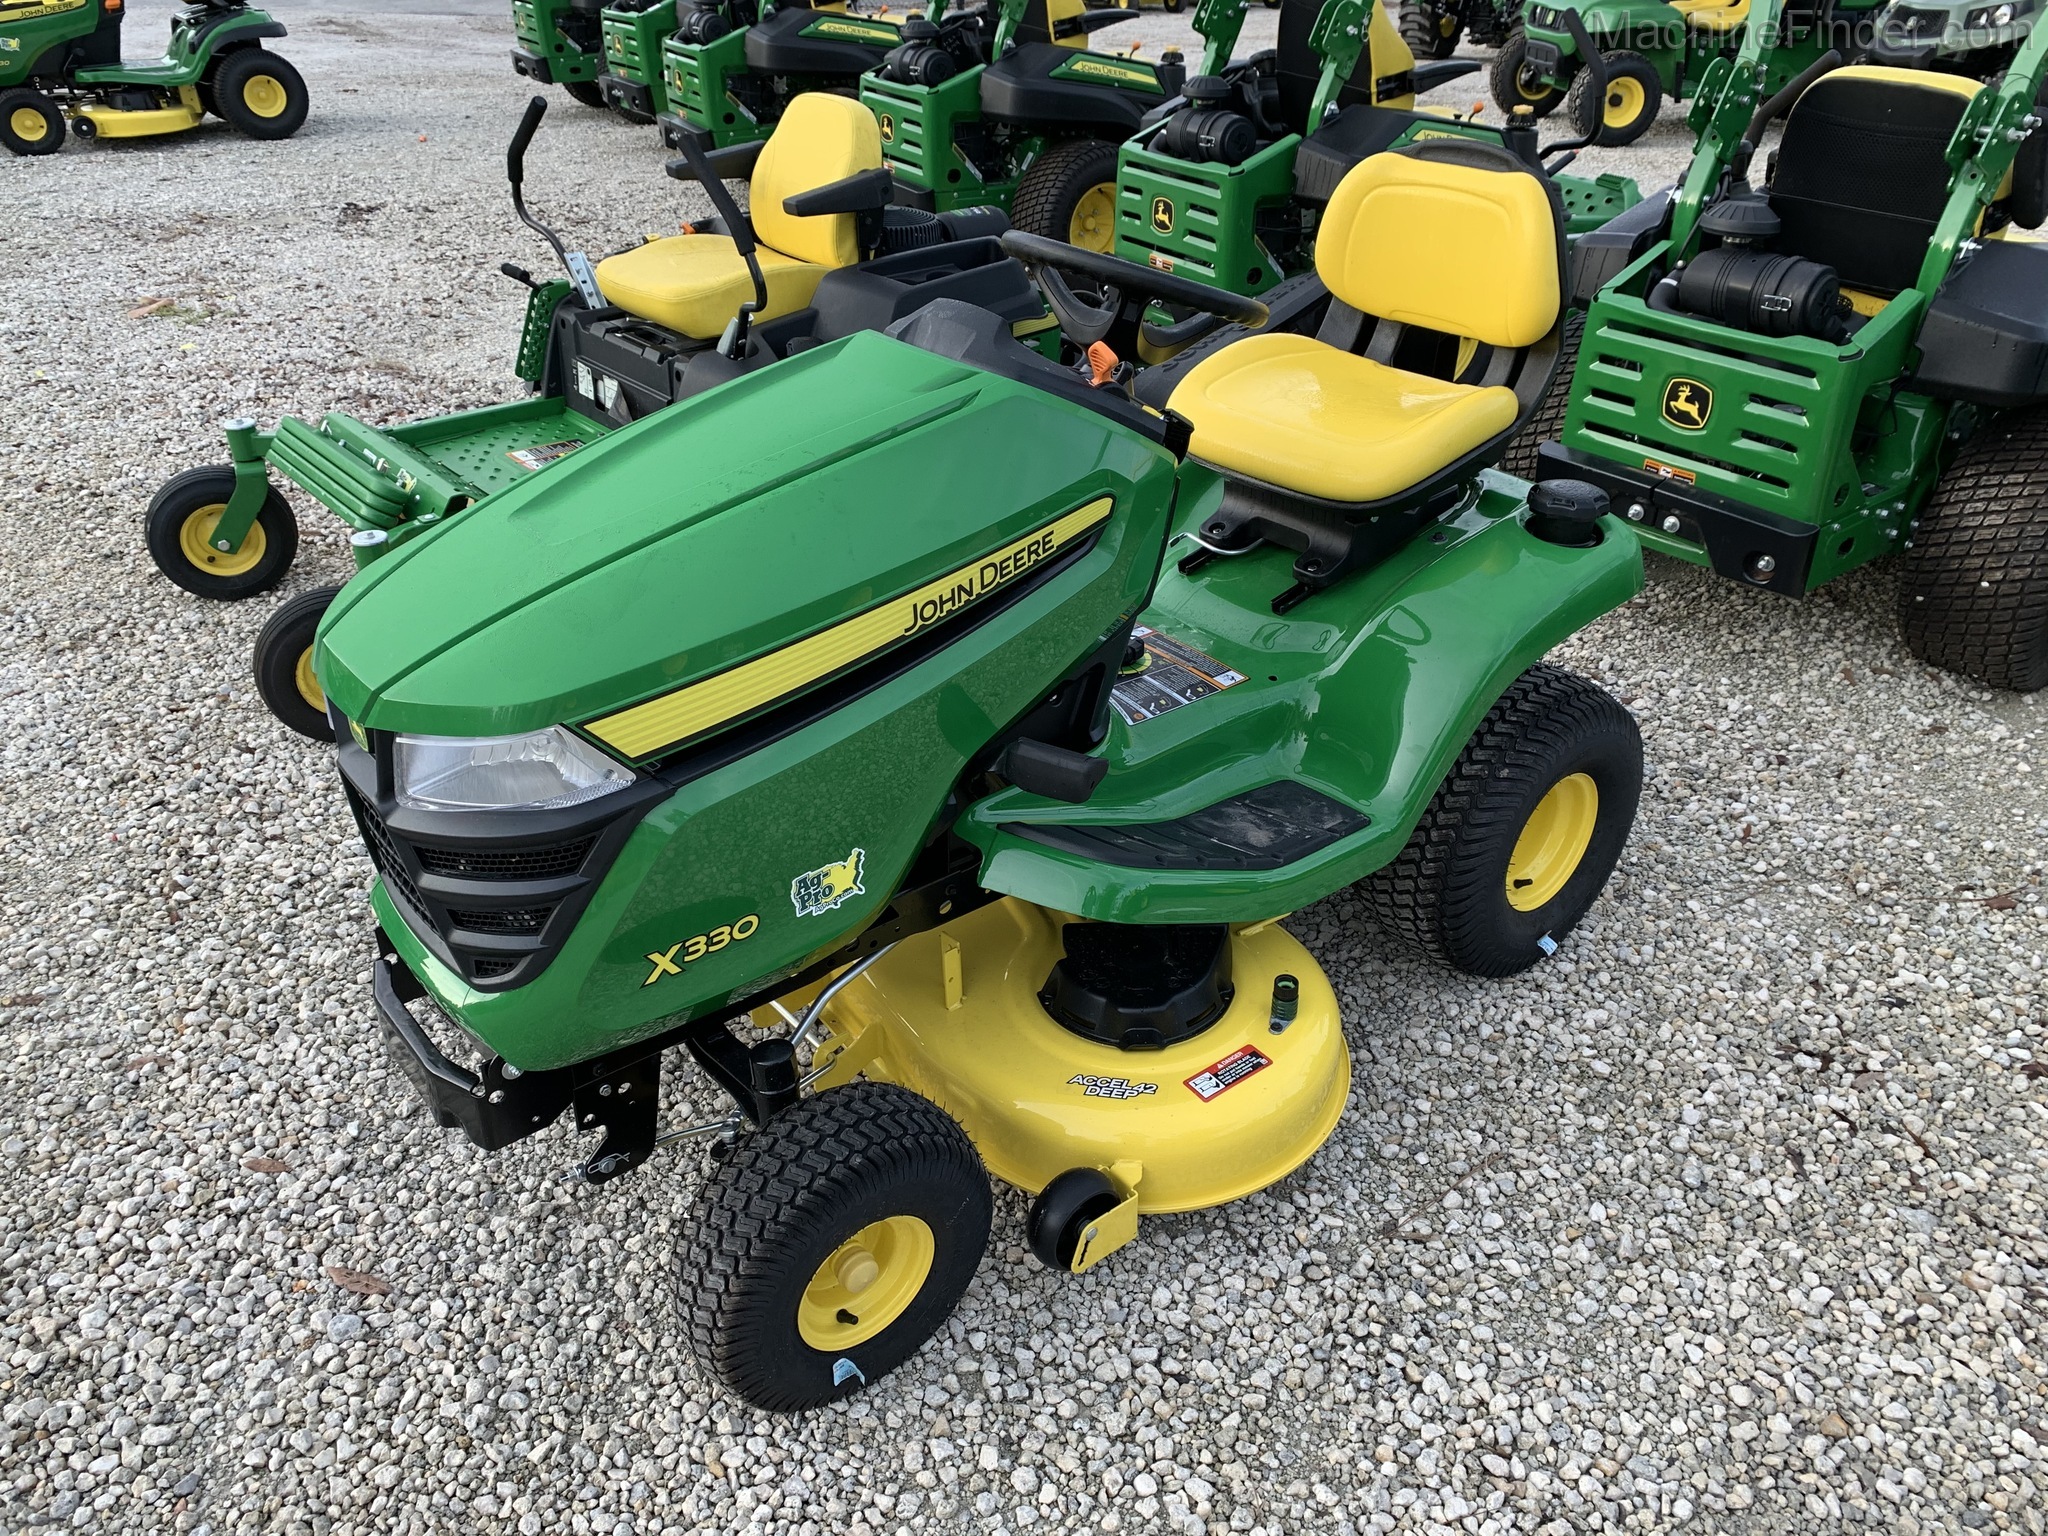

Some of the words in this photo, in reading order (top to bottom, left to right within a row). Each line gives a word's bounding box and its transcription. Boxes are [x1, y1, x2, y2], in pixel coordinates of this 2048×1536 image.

[19, 8, 44, 18] JOHN
[45, 2, 75, 13] DEERE
[826, 23, 846, 32] JOHN
[846, 25, 872, 35] DEERE
[1081, 62, 1101, 73] JOHN
[1102, 65, 1129, 78] DEERE
[904, 576, 974, 636] JOHN
[979, 529, 1057, 593] DEERE
[798, 884, 834, 913] Pro
[640, 913, 760, 989] X330
[1220, 1051, 1244, 1067] DANGER
[1066, 1074, 1131, 1090] ACCEL
[1132, 1082, 1159, 1095] 42
[1083, 1085, 1140, 1099] DEEP
